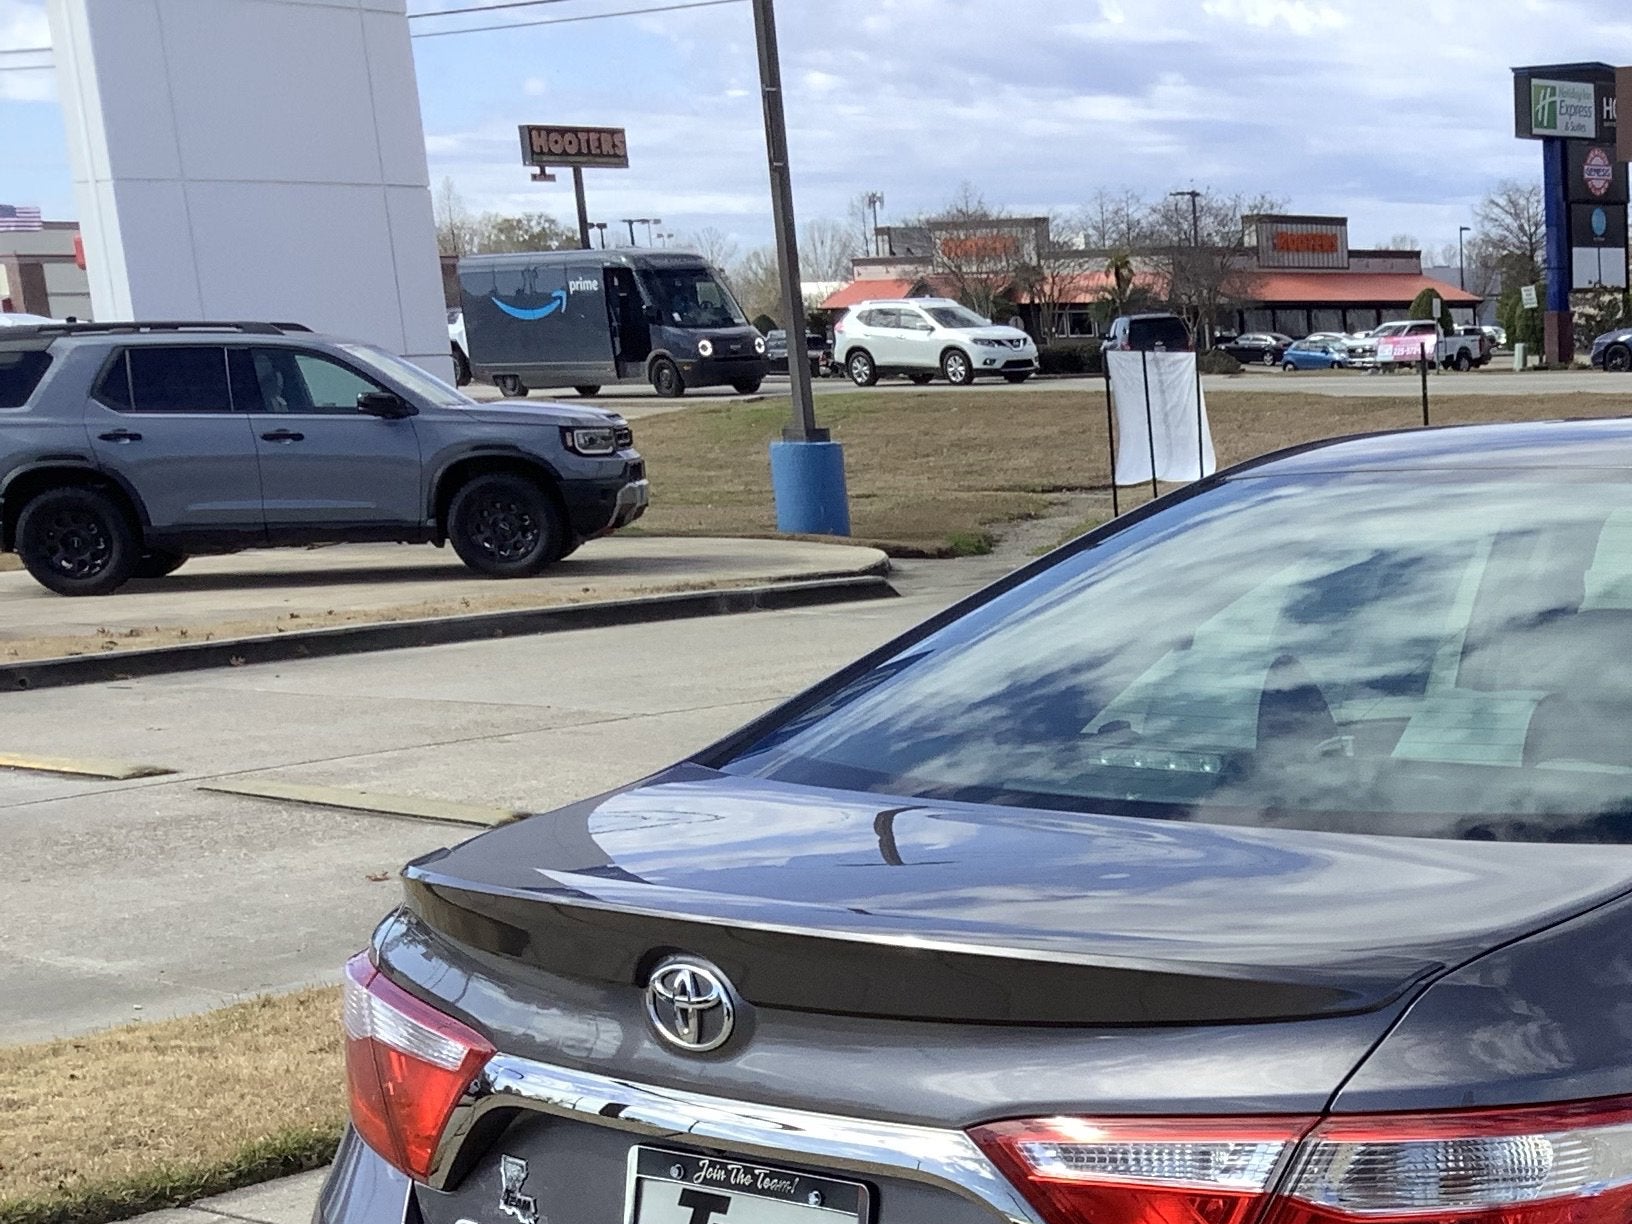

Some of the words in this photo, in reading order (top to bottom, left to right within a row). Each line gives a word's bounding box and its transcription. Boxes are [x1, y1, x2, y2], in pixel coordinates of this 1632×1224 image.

[1559, 100, 1593, 120] Express
[531, 129, 624, 155] HOOTERS
[569, 276, 599, 295] prime
[692, 1159, 727, 1184] Join
[726, 1164, 753, 1186] The
[753, 1169, 800, 1194] Team!
